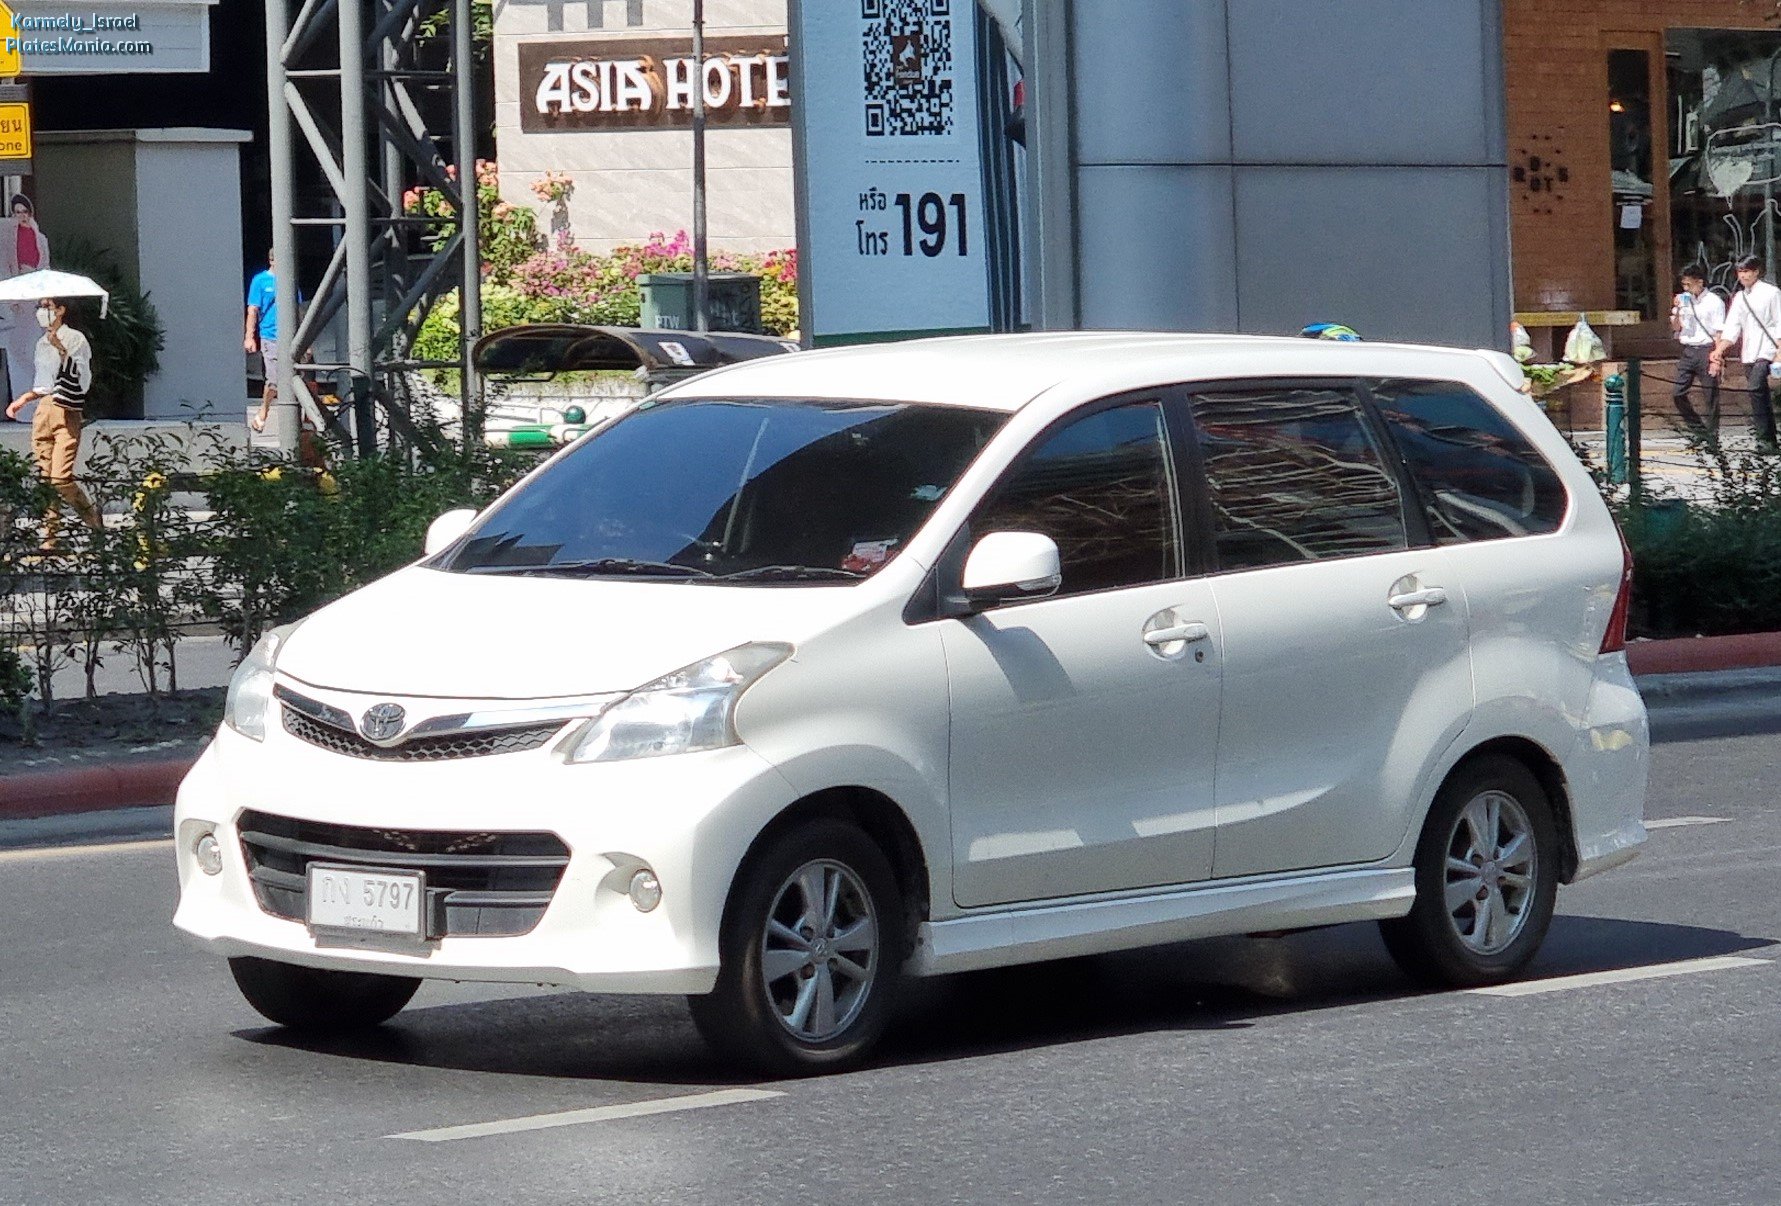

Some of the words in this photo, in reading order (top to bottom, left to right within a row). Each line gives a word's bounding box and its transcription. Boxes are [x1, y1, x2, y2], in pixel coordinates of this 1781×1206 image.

[535, 59, 652, 113] ASIA
[859, 186, 887, 211] หรือ
[855, 219, 889, 256] โทร
[894, 192, 967, 257] 191
[363, 879, 414, 910] 5797
